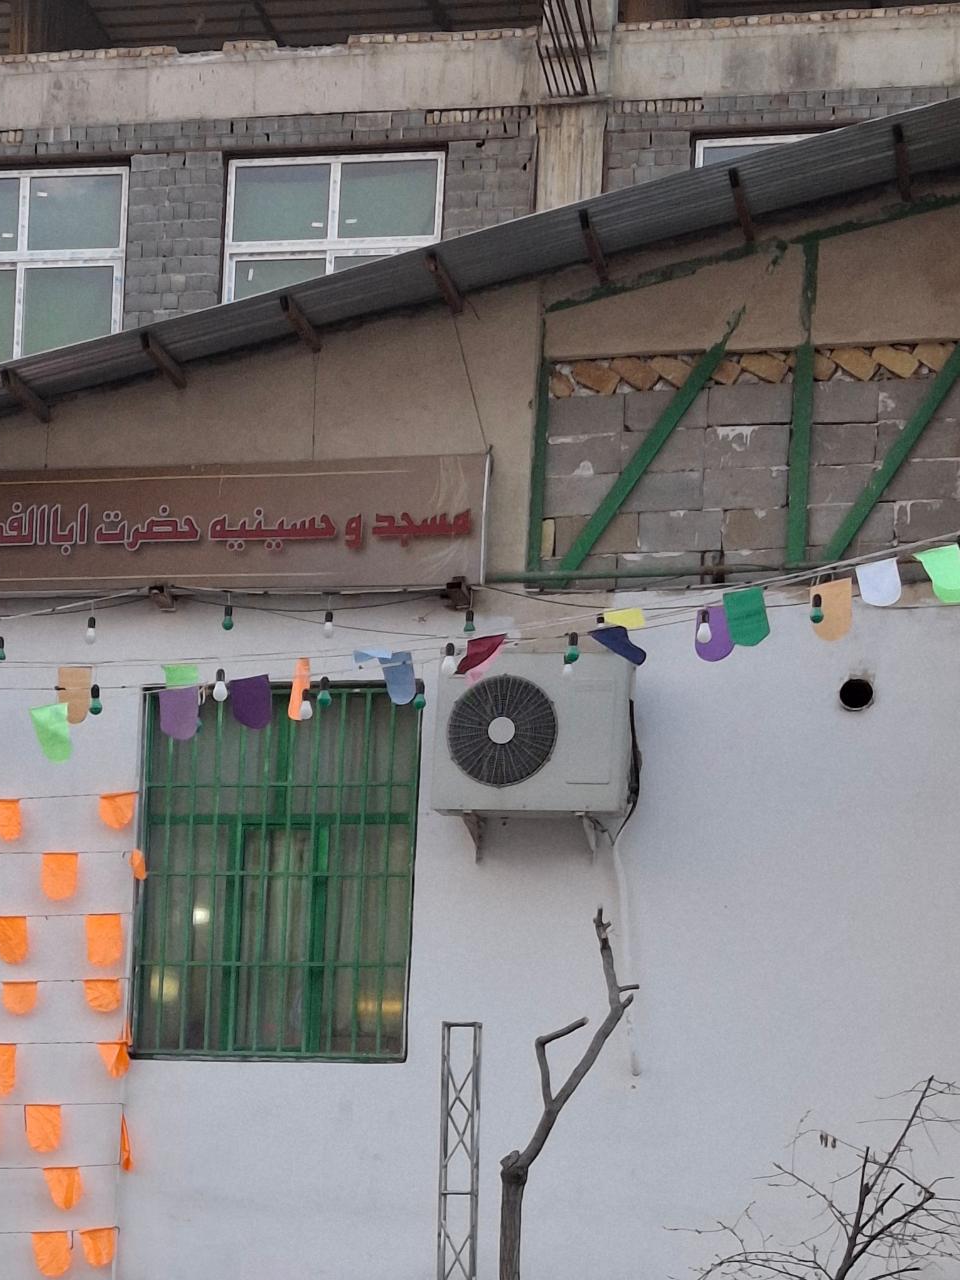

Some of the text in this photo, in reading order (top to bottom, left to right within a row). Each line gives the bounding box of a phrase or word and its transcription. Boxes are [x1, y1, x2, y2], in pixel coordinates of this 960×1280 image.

[95, 504, 200, 550] حضرت
[208, 507, 336, 551] حسینیه
[344, 513, 362, 550] و
[371, 508, 471, 548] مسجد
